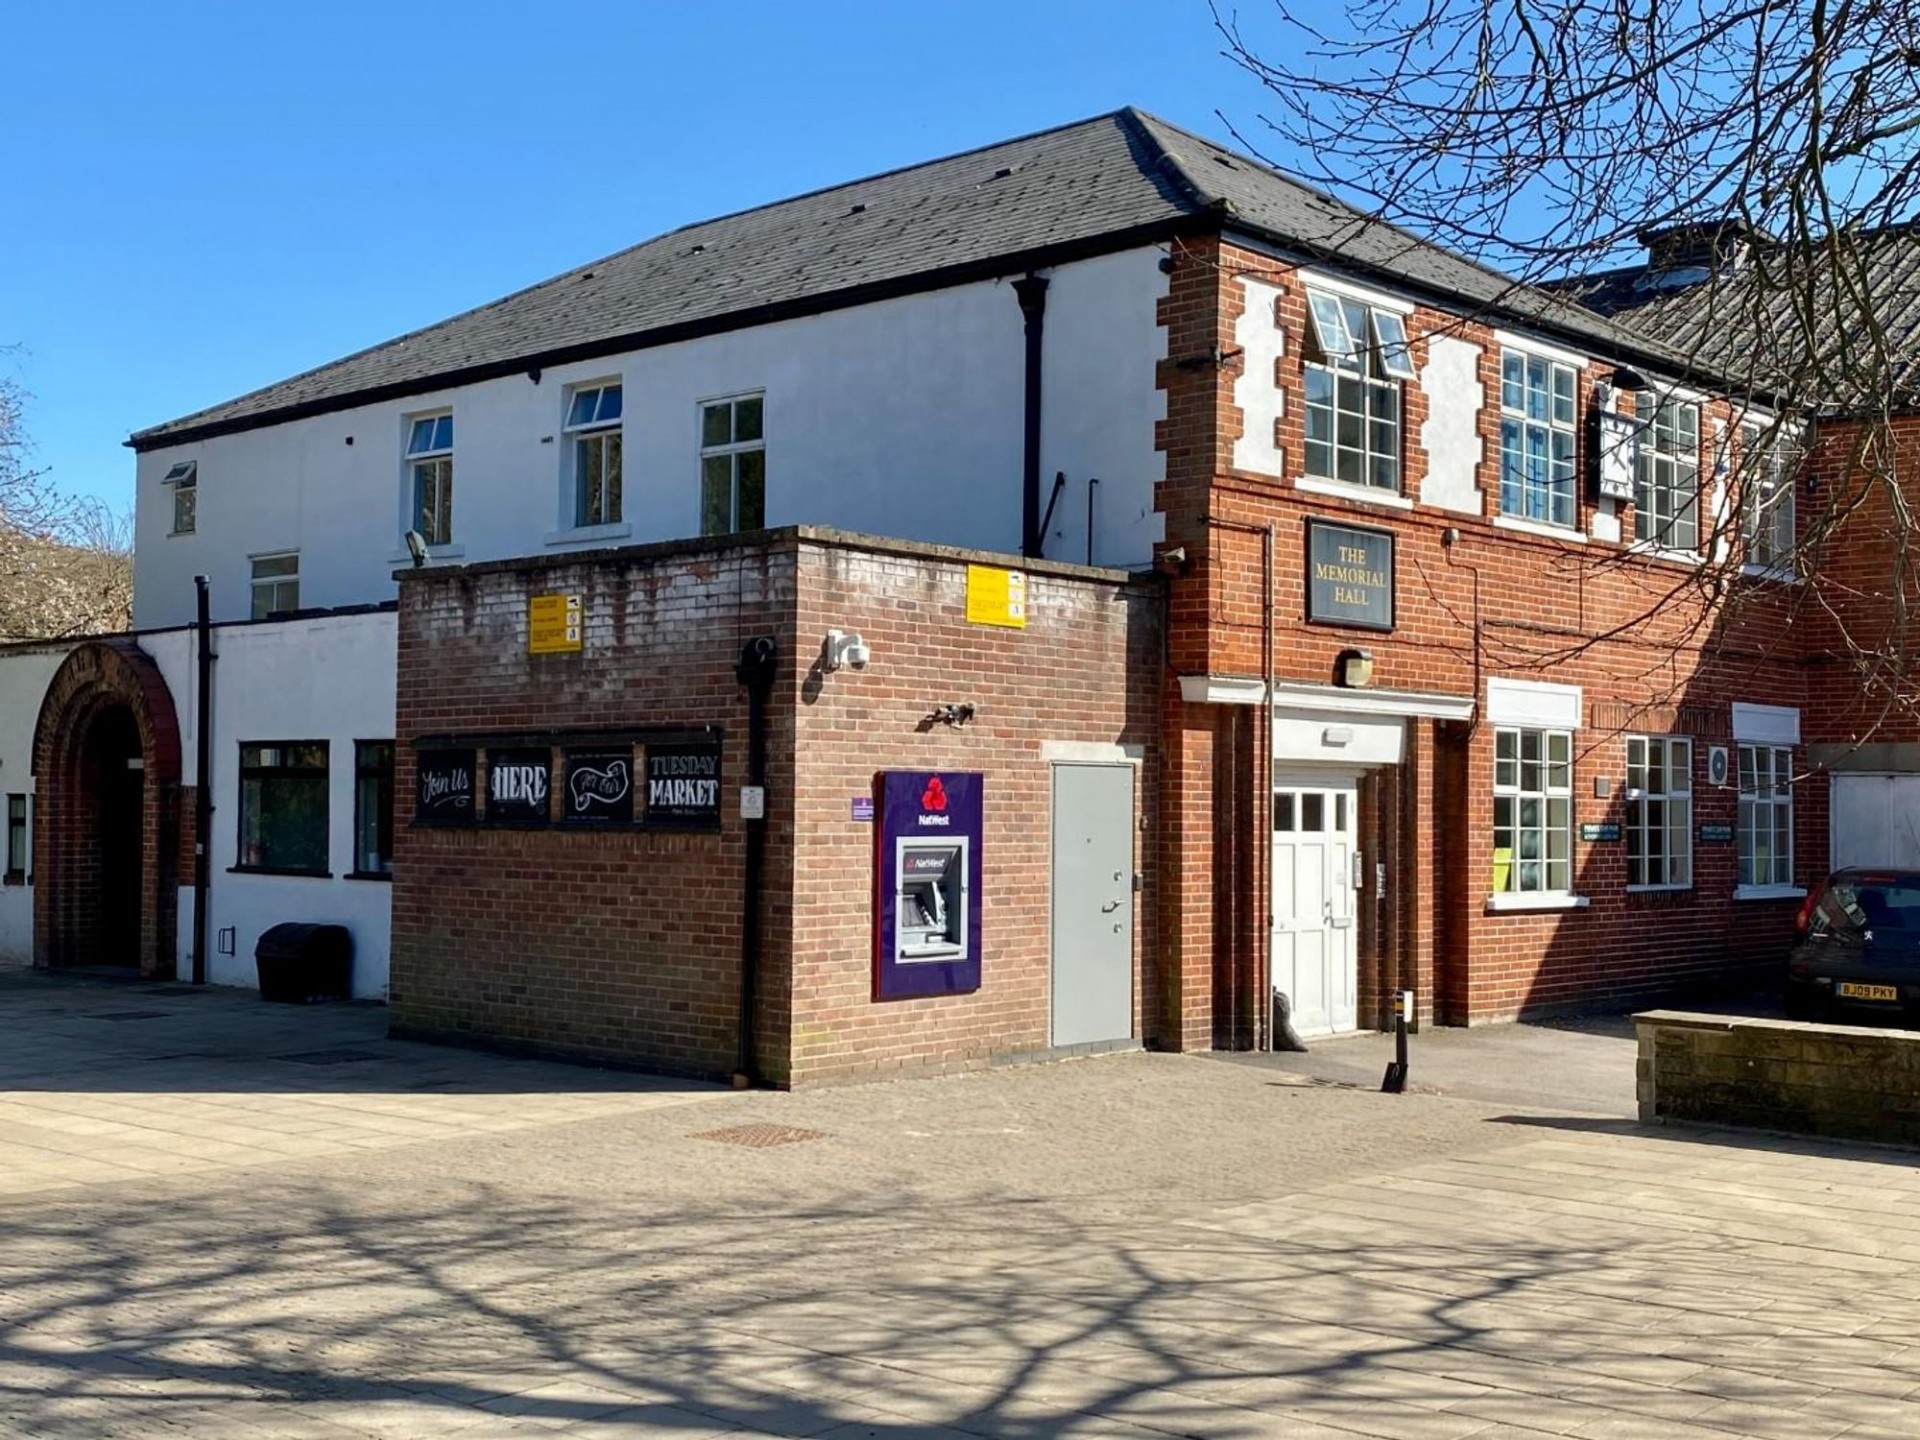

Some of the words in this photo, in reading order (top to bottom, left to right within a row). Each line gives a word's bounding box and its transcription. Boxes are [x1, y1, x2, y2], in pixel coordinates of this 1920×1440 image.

[1339, 546, 1366, 564] THE
[1315, 563, 1387, 587] MEMORIAL
[1335, 587, 1369, 605] HALL
[650, 755, 718, 775] TUESDAY
[422, 770, 449, 803] Join
[452, 768, 468, 791] Us
[491, 766, 547, 806] HERE
[649, 779, 719, 806] MARKET
[918, 814, 950, 826] NatWest
[914, 857, 946, 868] NatWest
[1873, 987, 1895, 998] PKY
